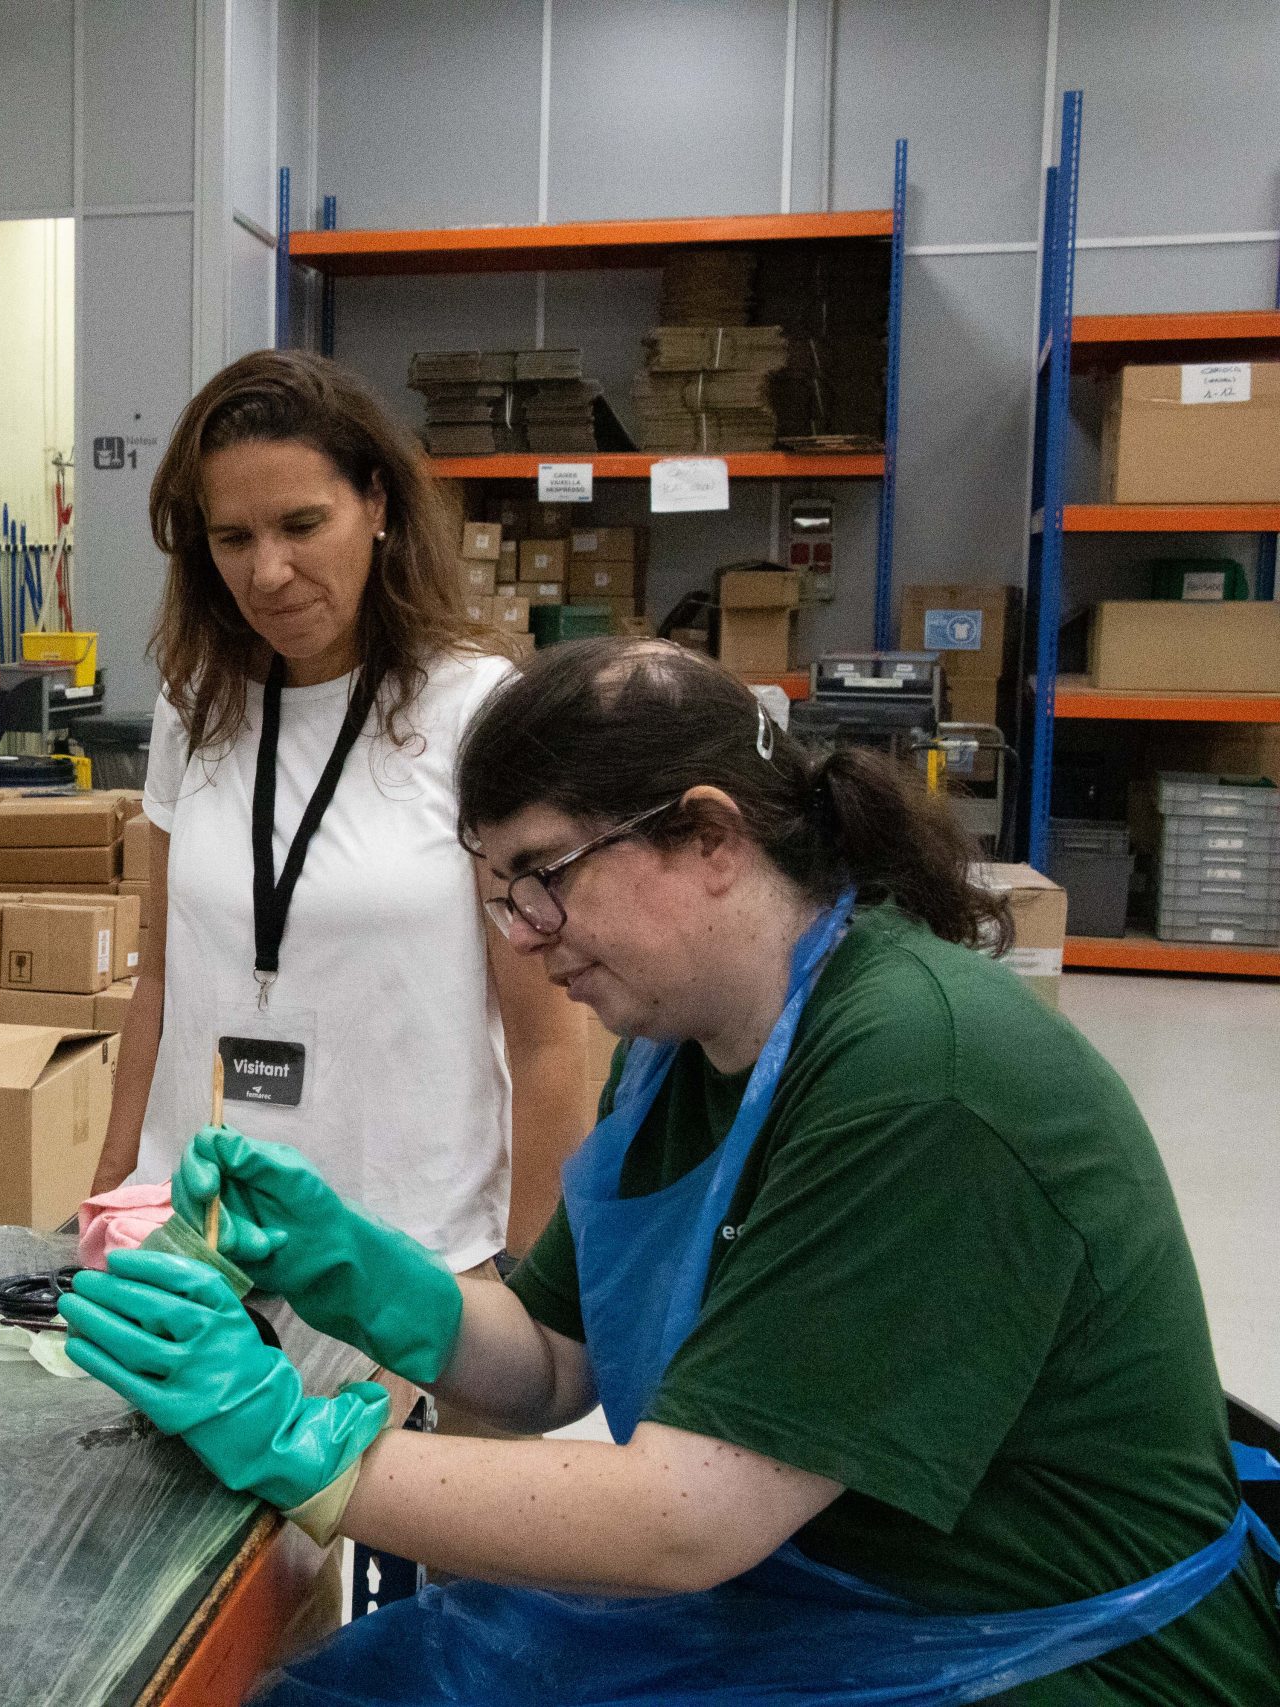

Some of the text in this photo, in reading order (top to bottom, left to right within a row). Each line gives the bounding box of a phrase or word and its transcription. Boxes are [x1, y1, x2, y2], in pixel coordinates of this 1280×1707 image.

[127, 449, 136, 469] 1
[233, 1058, 290, 1078] Visitant
[246, 1090, 271, 1100] femarec
